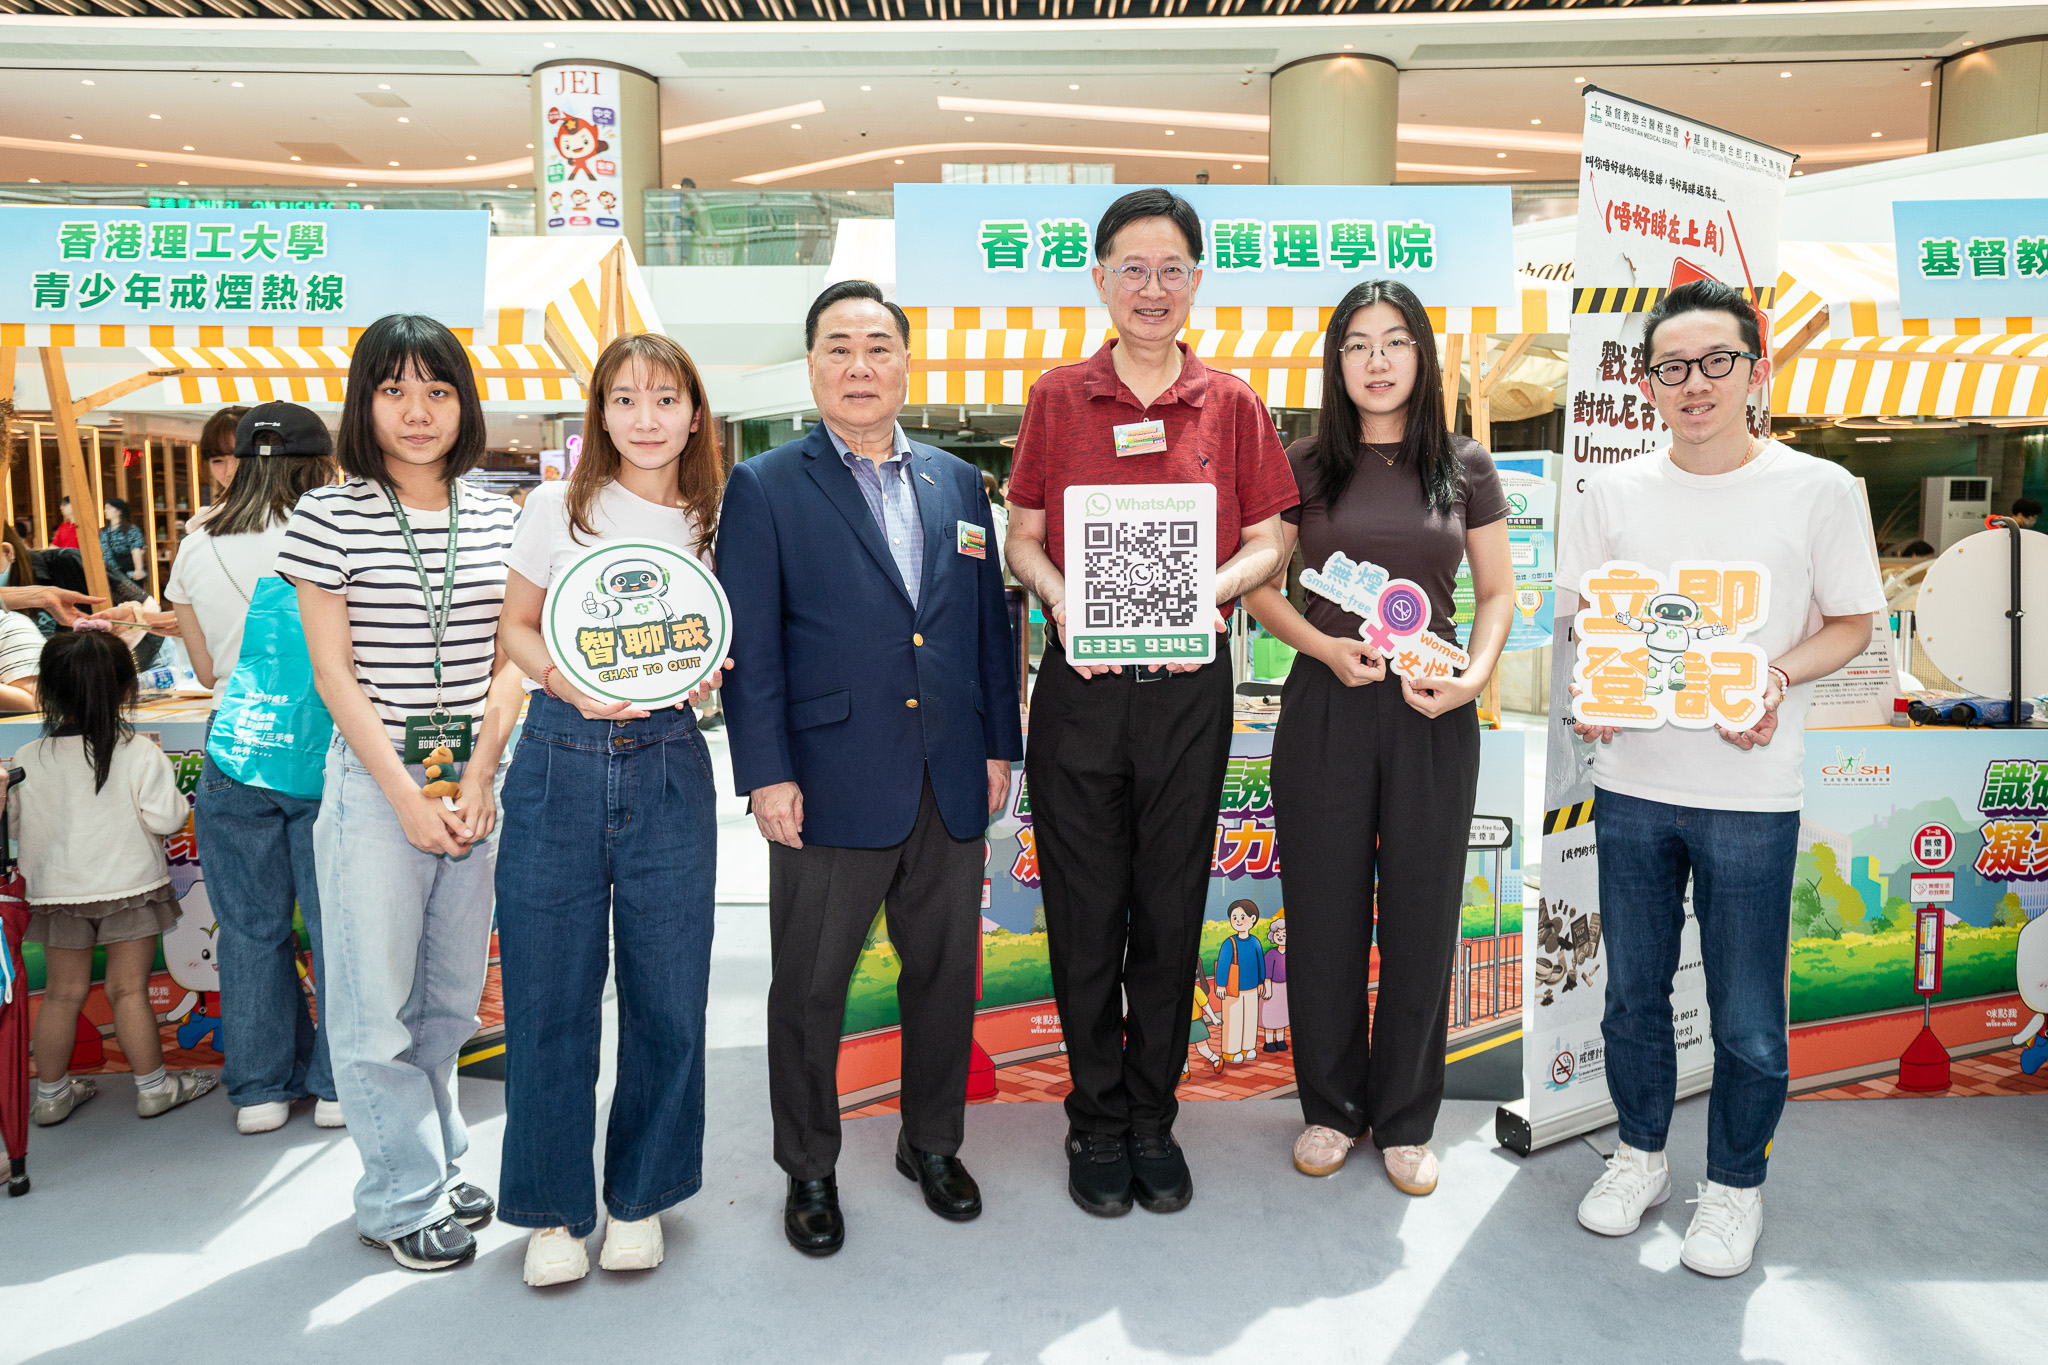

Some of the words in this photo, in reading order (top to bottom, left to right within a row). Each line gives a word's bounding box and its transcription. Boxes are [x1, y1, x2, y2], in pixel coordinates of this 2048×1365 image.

[555, 71, 601, 95] JEI
[1604, 120, 1621, 131] UNITED
[1605, 199, 1725, 257] (唔好睇左上角)
[60, 223, 325, 261] 香港理工大學
[981, 221, 1434, 269] 香港護理學院
[33, 272, 344, 311] 青少年戒煙熱線
[1573, 390, 1668, 432] 對抗尼古
[1115, 496, 1196, 513] WhatsApp
[1327, 556, 1385, 596] 無煙
[1305, 573, 1372, 614] Smoke-free
[1583, 568, 1761, 636] 立即
[578, 615, 710, 668] 智聊戒
[1078, 638, 1136, 655] 6335
[1144, 637, 1204, 653] 9345
[1420, 632, 1466, 665] Women
[599, 666, 639, 683] CHAT
[643, 662, 664, 676] TO
[667, 656, 702, 671] QUIT
[1396, 650, 1449, 678] 女性
[1580, 646, 1757, 723] 登記
[418, 740, 439, 750] HONG
[1821, 765, 1890, 776] COSH
[1924, 838, 1942, 848] 無煙
[1924, 848, 1942, 857] 香港
[1680, 1008, 1698, 1021] 9012
[1986, 1008, 2018, 1019] 咪點我
[1675, 1025, 1693, 1040] (中文)
[1579, 1046, 1605, 1064] 戒煙計
